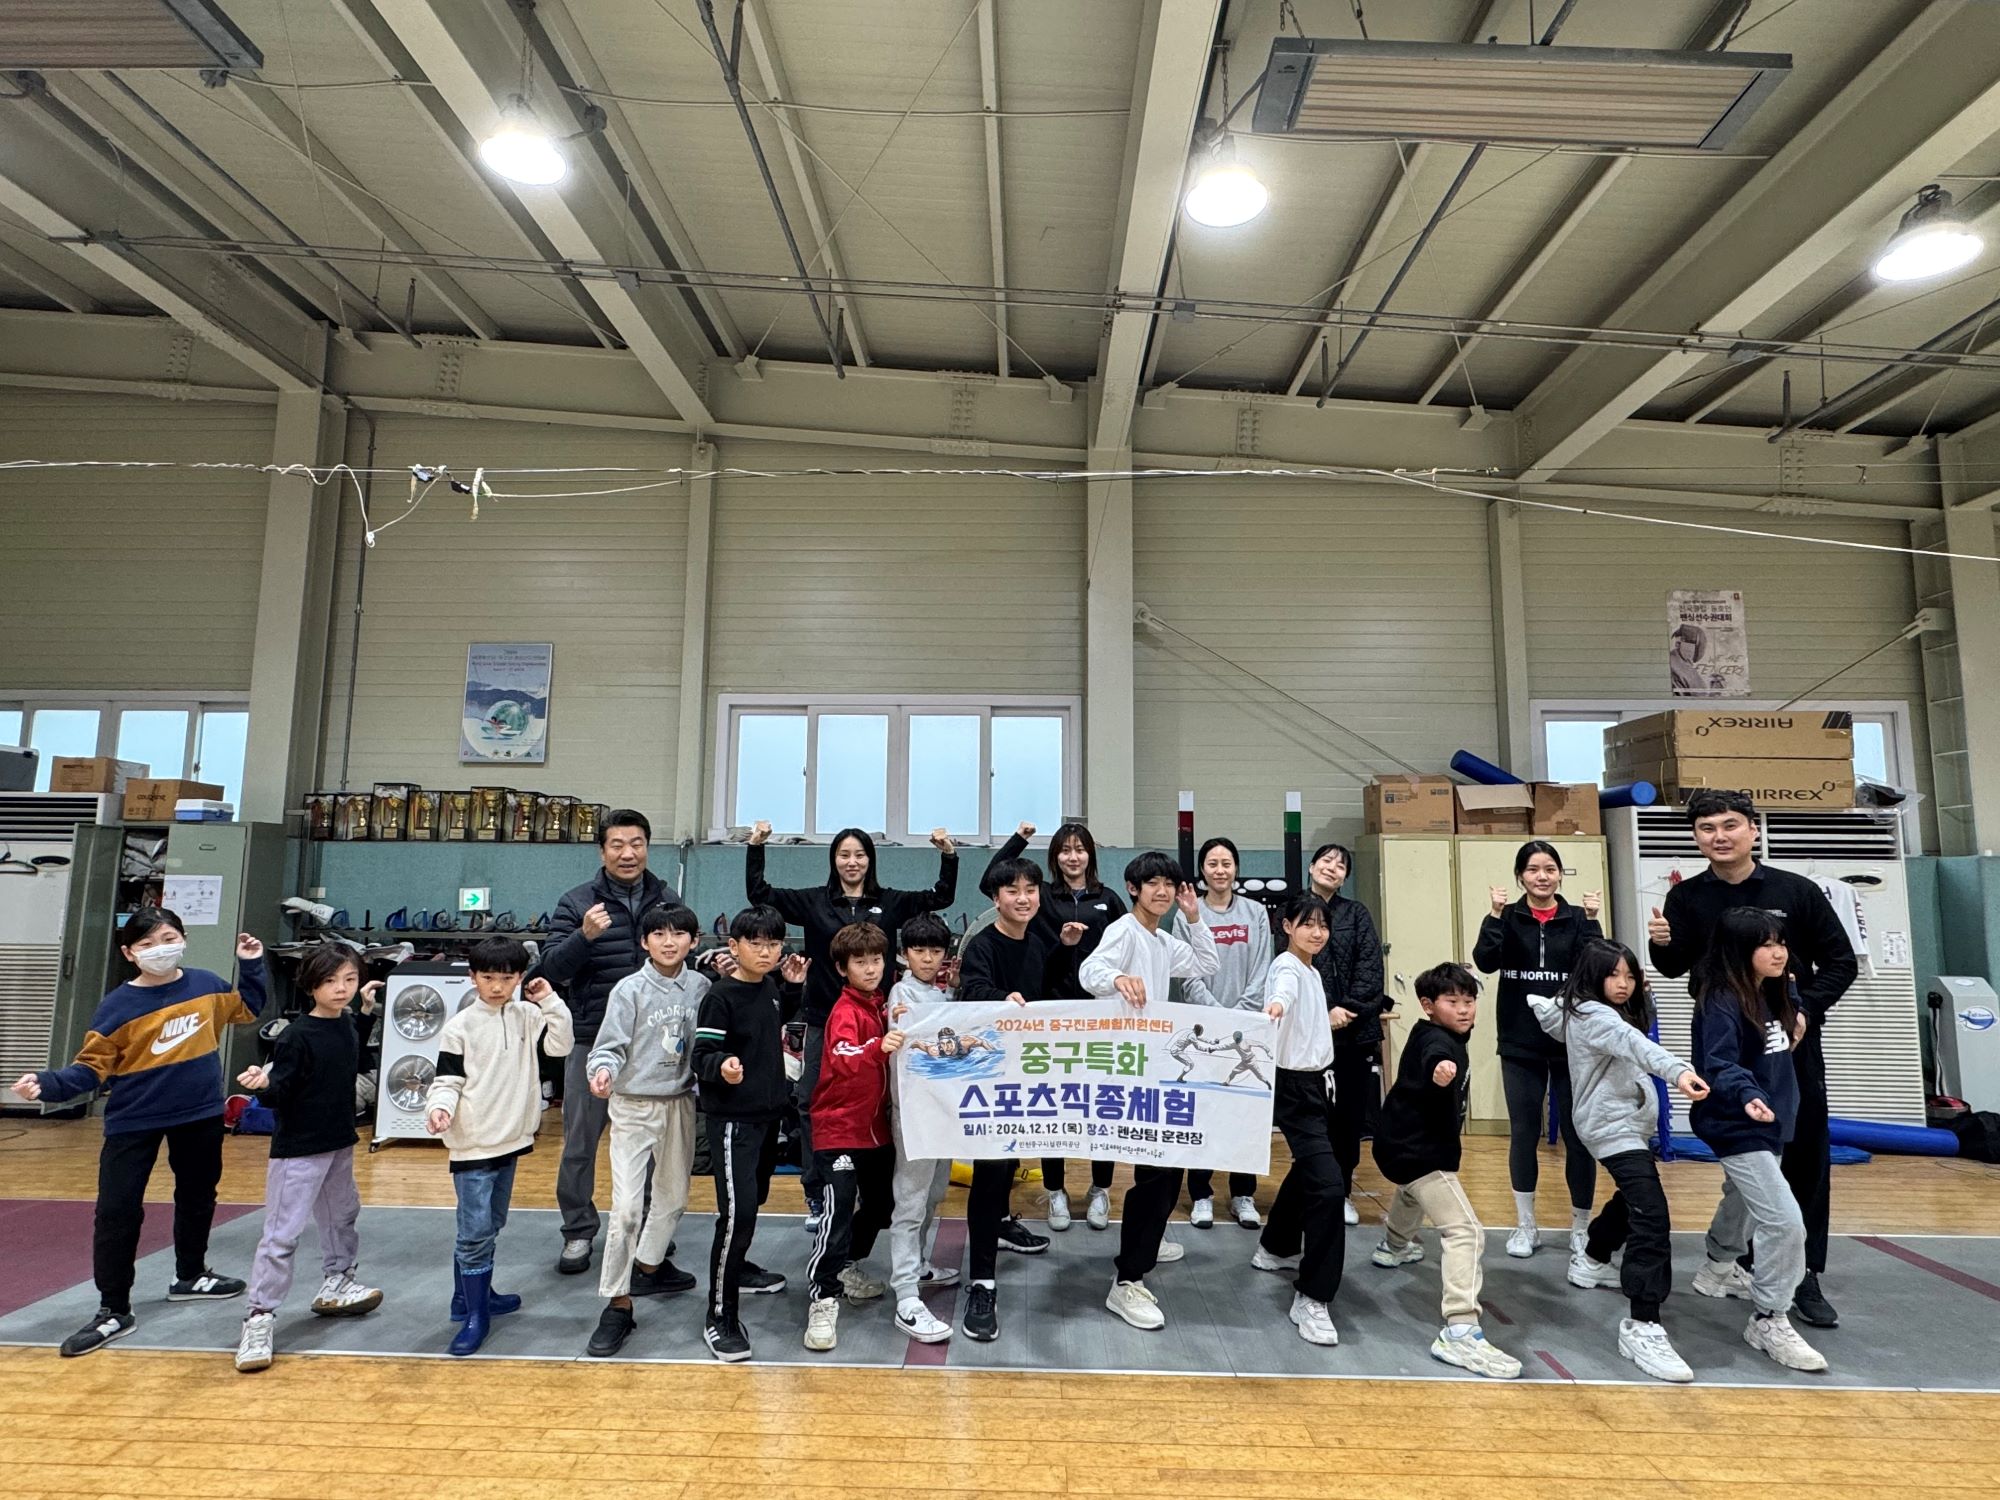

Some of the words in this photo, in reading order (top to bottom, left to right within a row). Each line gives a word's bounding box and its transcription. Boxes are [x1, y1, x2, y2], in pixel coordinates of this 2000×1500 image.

[1708, 717, 1793, 729] AIRREX
[1744, 788, 1823, 801] AIRREX
[1520, 970, 1559, 981] NORTH
[160, 1012, 200, 1040] NIKE
[995, 1019, 1044, 1032] 2024년
[1049, 1017, 1174, 1034] 중구진로체험지원센터
[1020, 1041, 1149, 1077] 중구특화
[958, 1082, 1196, 1127] 스포츠직종체험
[963, 1123, 993, 1136] 일시:
[996, 1123, 1058, 1135] 2024.12.12
[1062, 1122, 1083, 1135] (목)
[1086, 1123, 1114, 1137] 장소:
[1117, 1124, 1158, 1143] 펜싱팀
[1161, 1129, 1203, 1145] 훈련장
